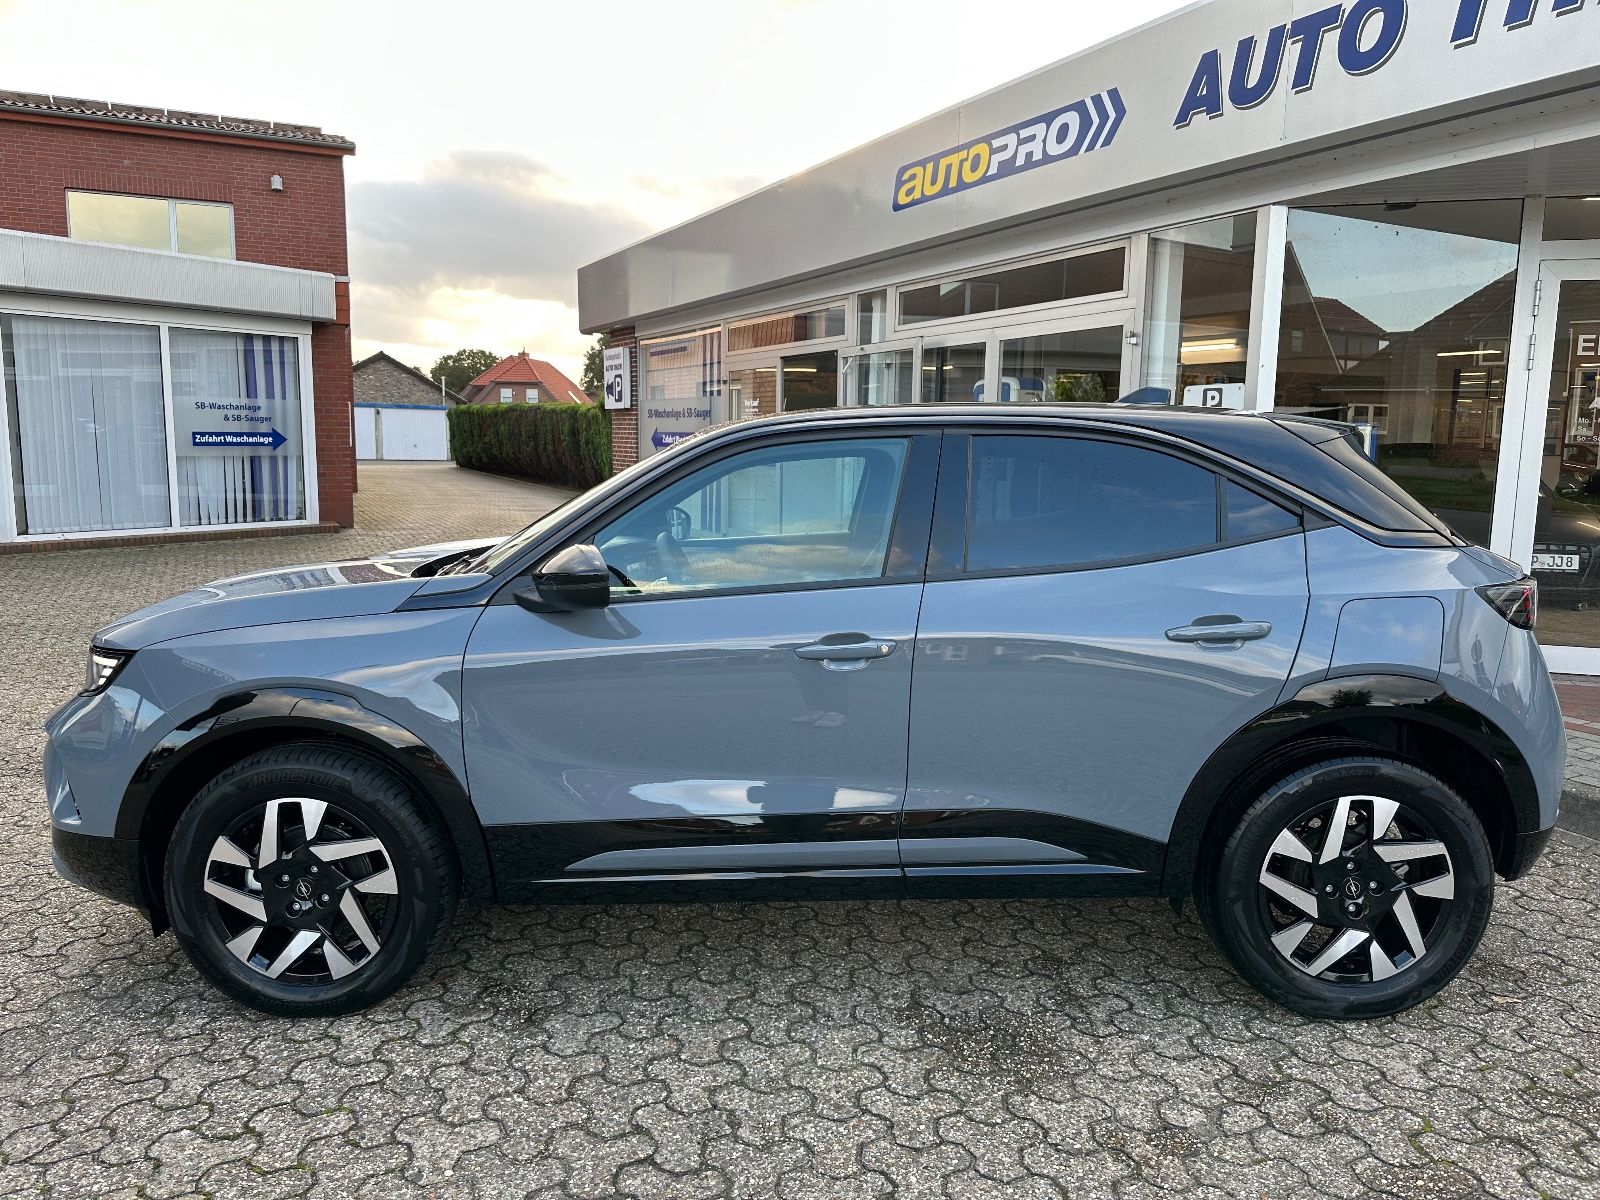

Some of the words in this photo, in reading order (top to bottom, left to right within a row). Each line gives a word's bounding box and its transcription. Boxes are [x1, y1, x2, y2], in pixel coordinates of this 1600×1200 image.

[1173, 0, 1407, 129] AUTO
[195, 401, 262, 413] SB-Waschanlage
[223, 414, 230, 422] &
[231, 414, 272, 424] SB-Sauger
[647, 408, 682, 421] SB-Waschanlage
[195, 434, 225, 443] Zufahrt
[225, 435, 273, 445] Waschanlage
